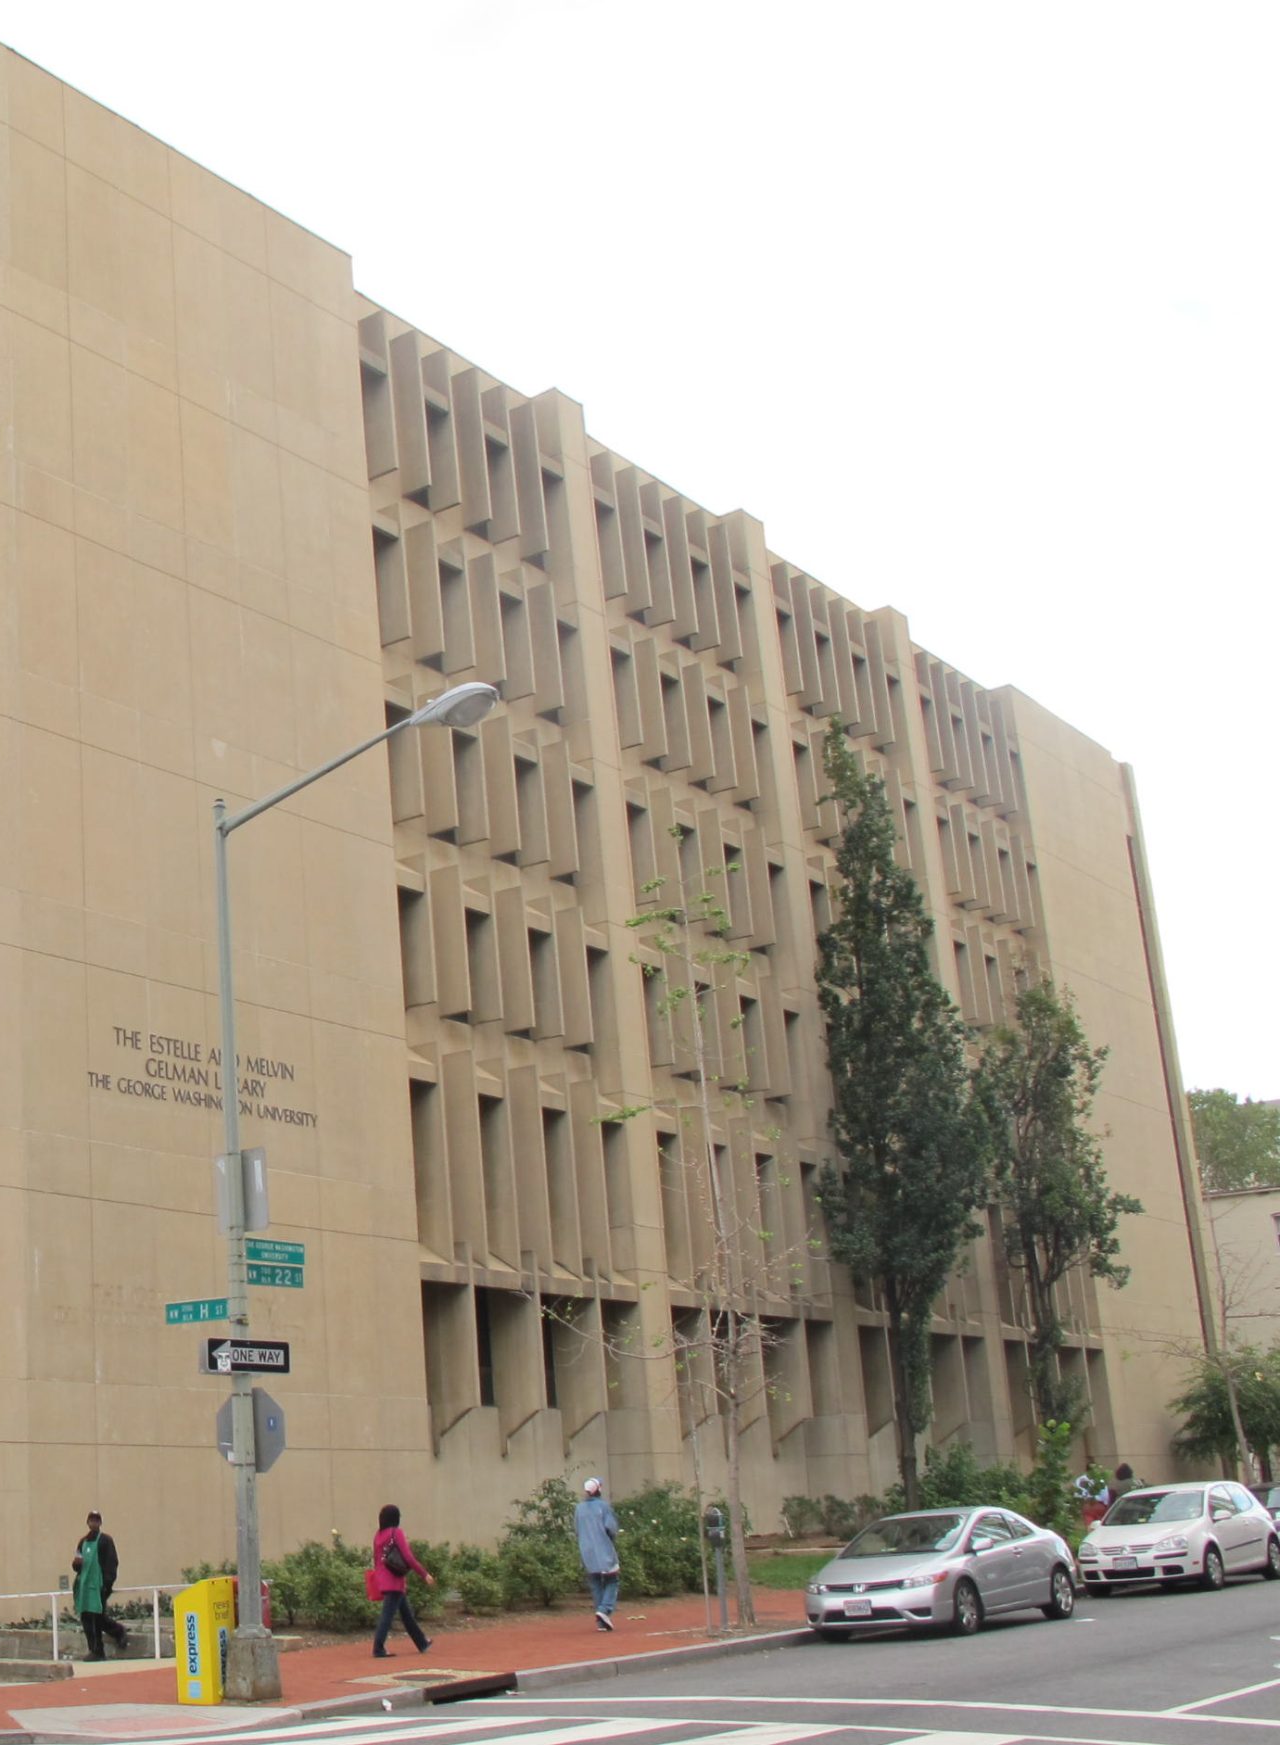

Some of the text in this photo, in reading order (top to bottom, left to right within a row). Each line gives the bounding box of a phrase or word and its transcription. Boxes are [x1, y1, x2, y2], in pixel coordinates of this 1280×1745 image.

[112, 1026, 142, 1050] THE
[149, 1033, 202, 1062] ESTELLE
[246, 1055, 295, 1081] MELVIN
[145, 1058, 266, 1098] GELMAN LARY
[87, 1071, 318, 1128] THE GEORGE WASHINON UNIVERSITY
[275, 1268, 292, 1285] 22
[199, 1303, 209, 1319] H
[215, 1304, 223, 1316] ST
[232, 1348, 281, 1363] ONE WAY
[187, 1614, 198, 1674] express
